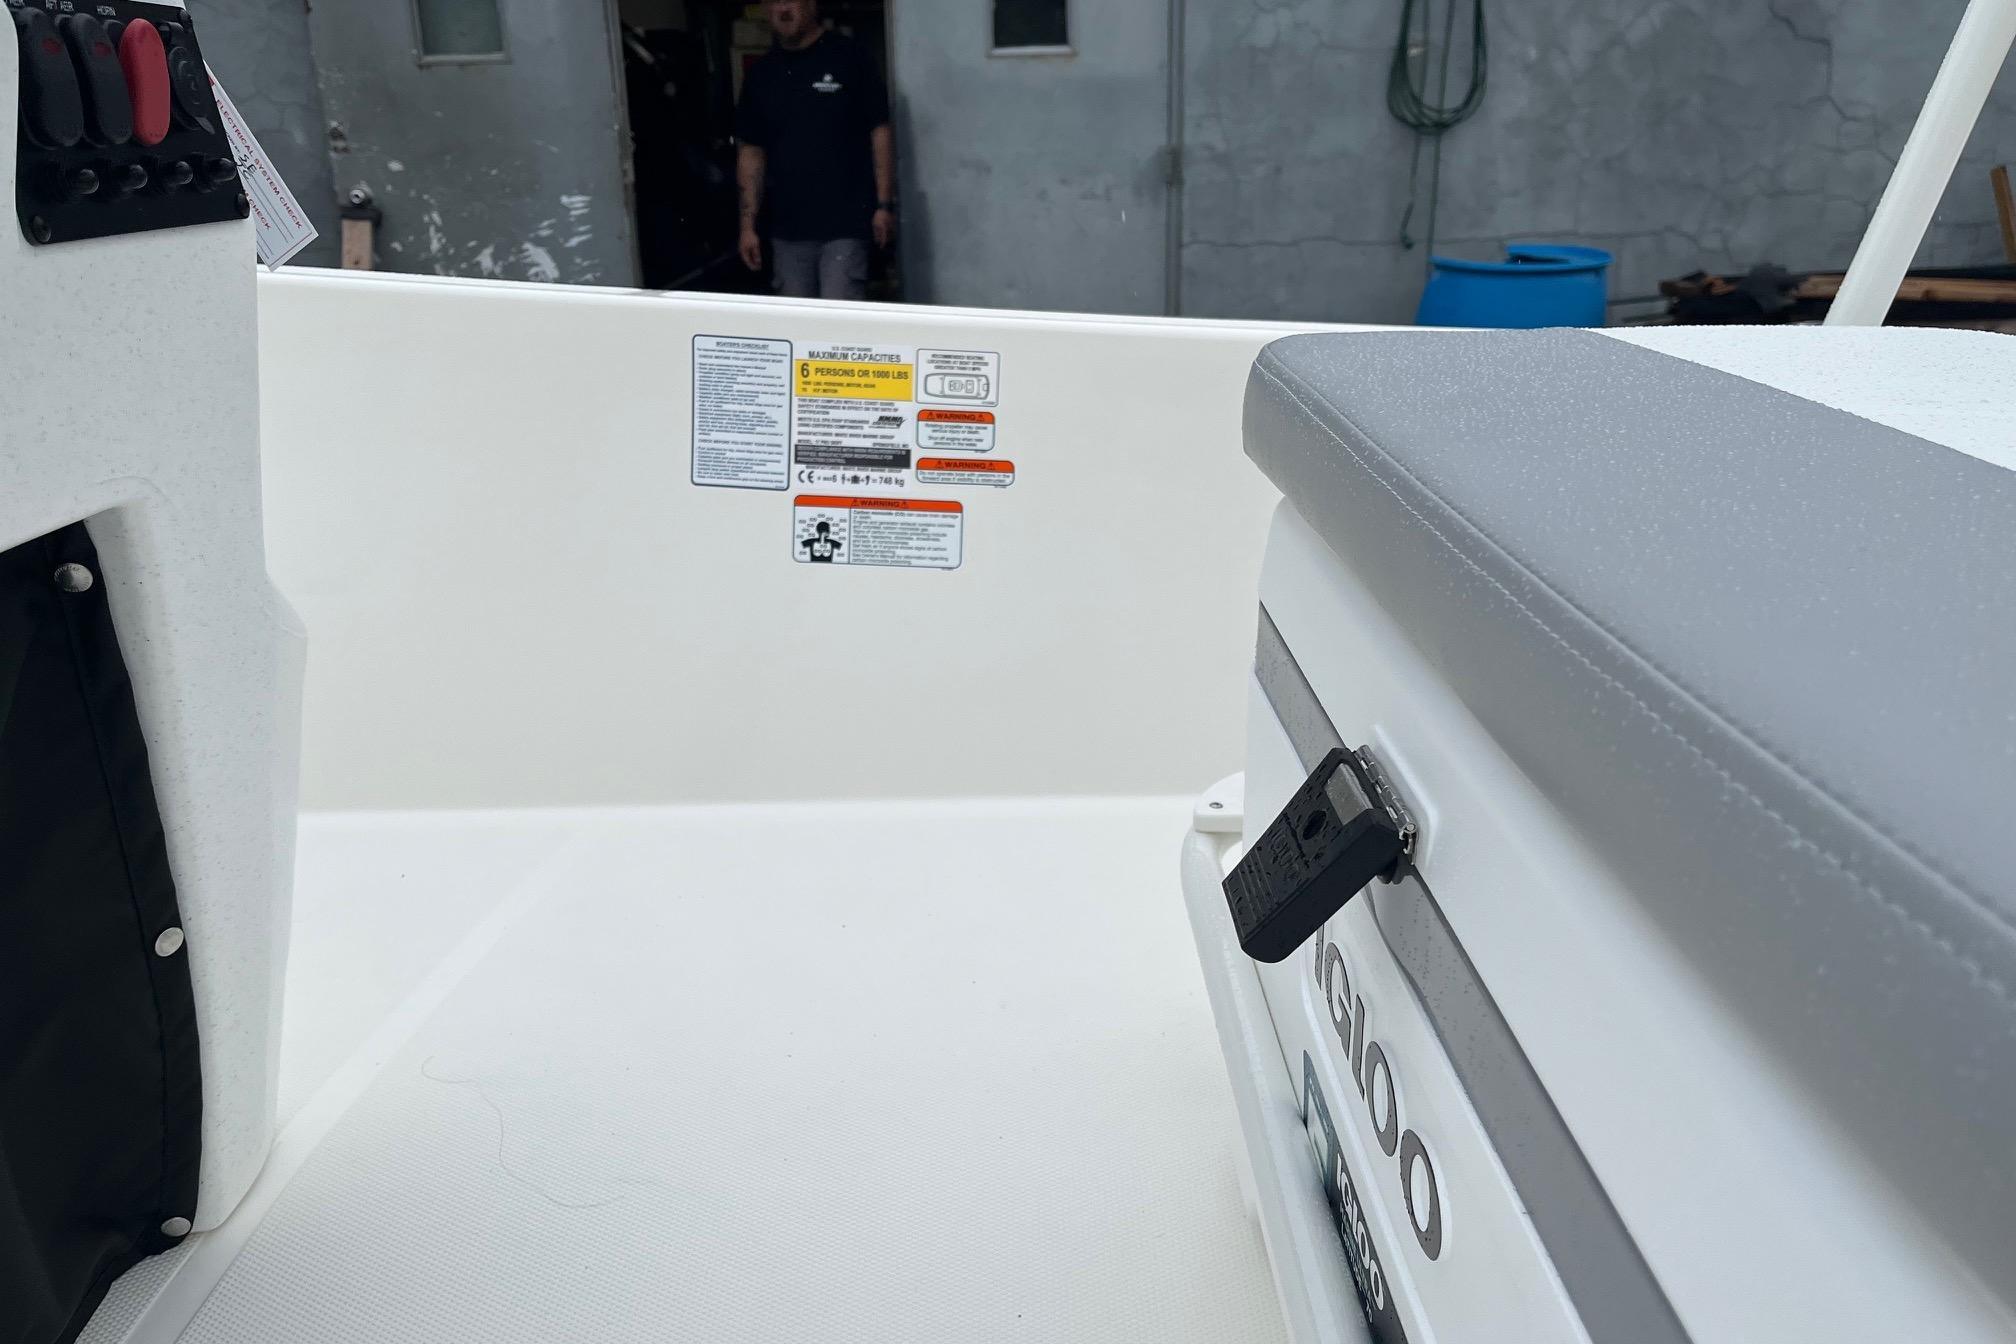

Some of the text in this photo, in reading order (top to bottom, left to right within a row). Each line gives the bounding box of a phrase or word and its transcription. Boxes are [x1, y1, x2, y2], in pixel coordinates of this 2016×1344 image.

[216, 99, 254, 158] ELECTRICAL
[254, 158, 280, 196] SYSTEM
[280, 196, 302, 229] CHECK
[249, 199, 271, 231] CHECK
[809, 351, 901, 362] MAXIMUM CAPACITIES
[801, 363, 809, 378] 6
[815, 367, 855, 378] PERSONS
[857, 370, 870, 378] OR
[892, 371, 909, 380] LBS
[895, 476, 904, 487] kg
